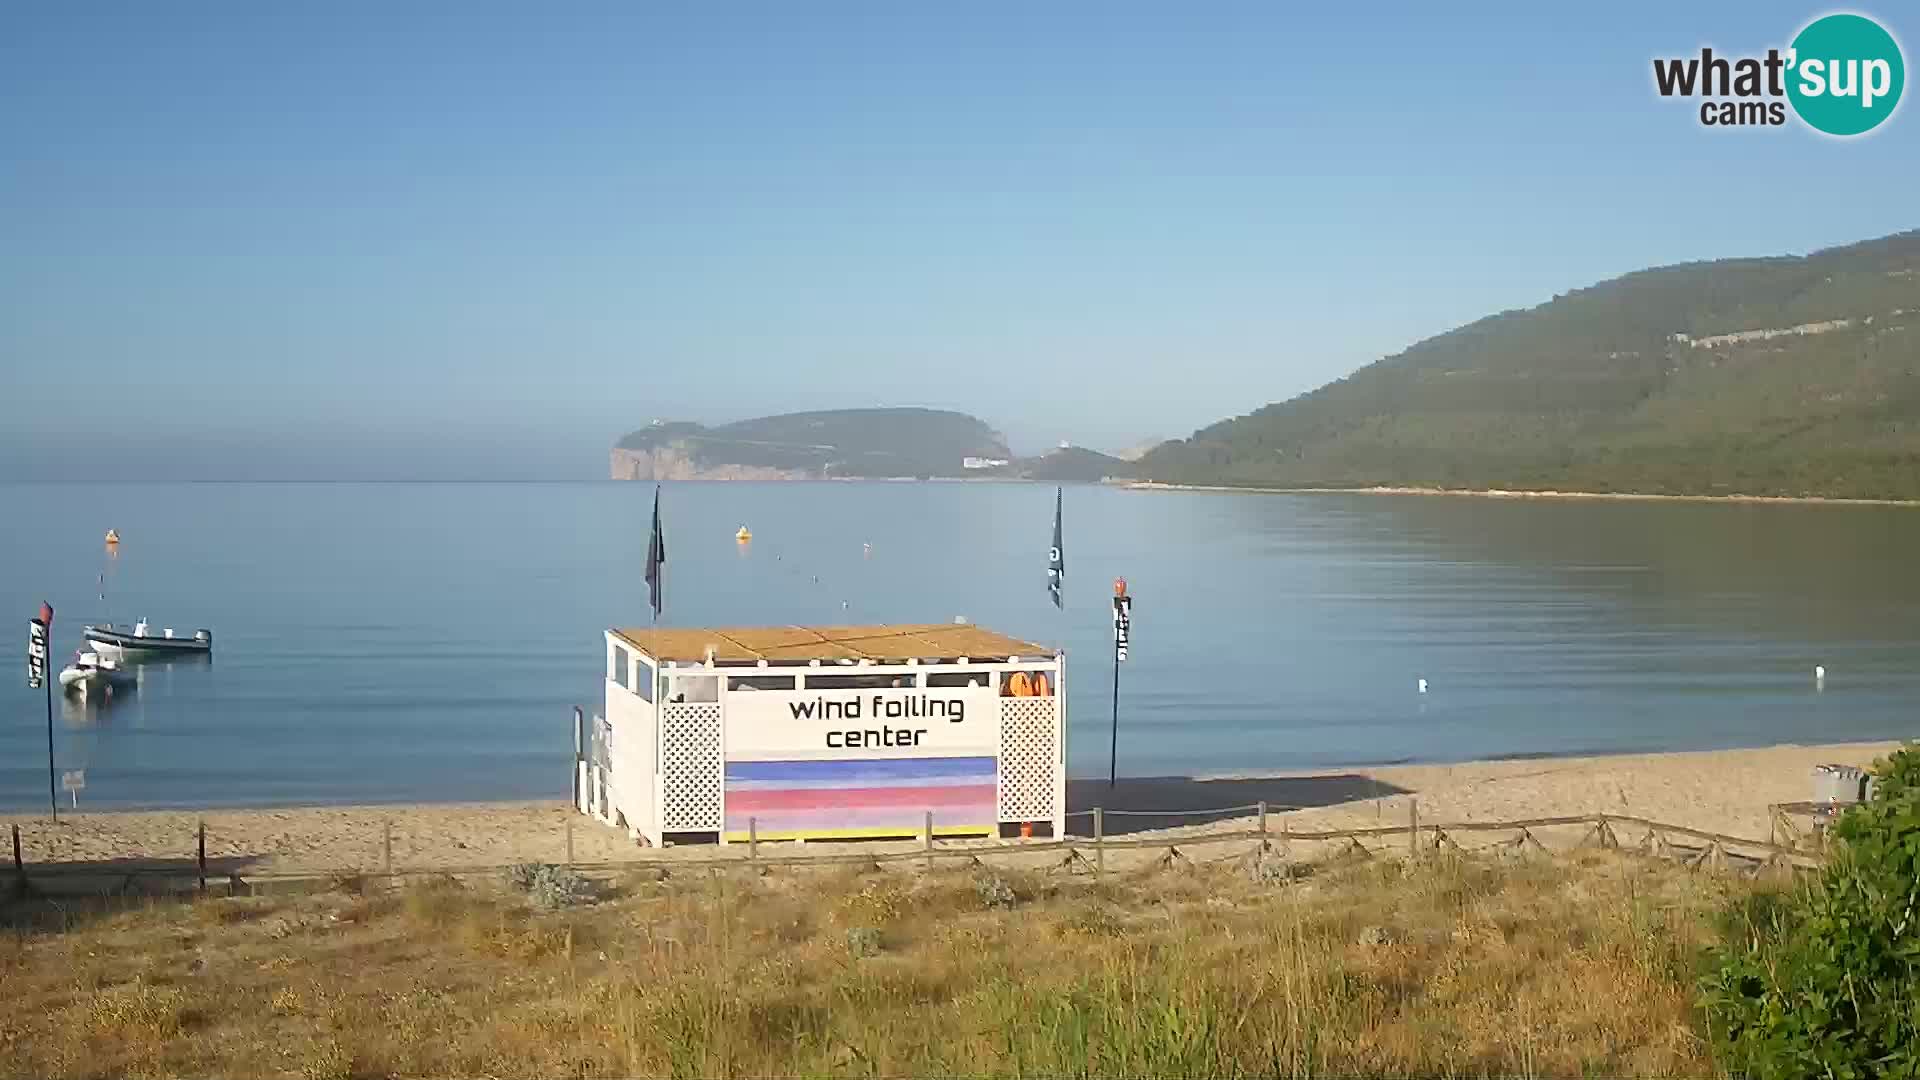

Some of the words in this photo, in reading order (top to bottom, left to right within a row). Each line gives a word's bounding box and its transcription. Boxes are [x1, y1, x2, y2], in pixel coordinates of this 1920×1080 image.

[788, 695, 861, 720] wind
[873, 694, 965, 723] foiling
[826, 725, 928, 748] center
